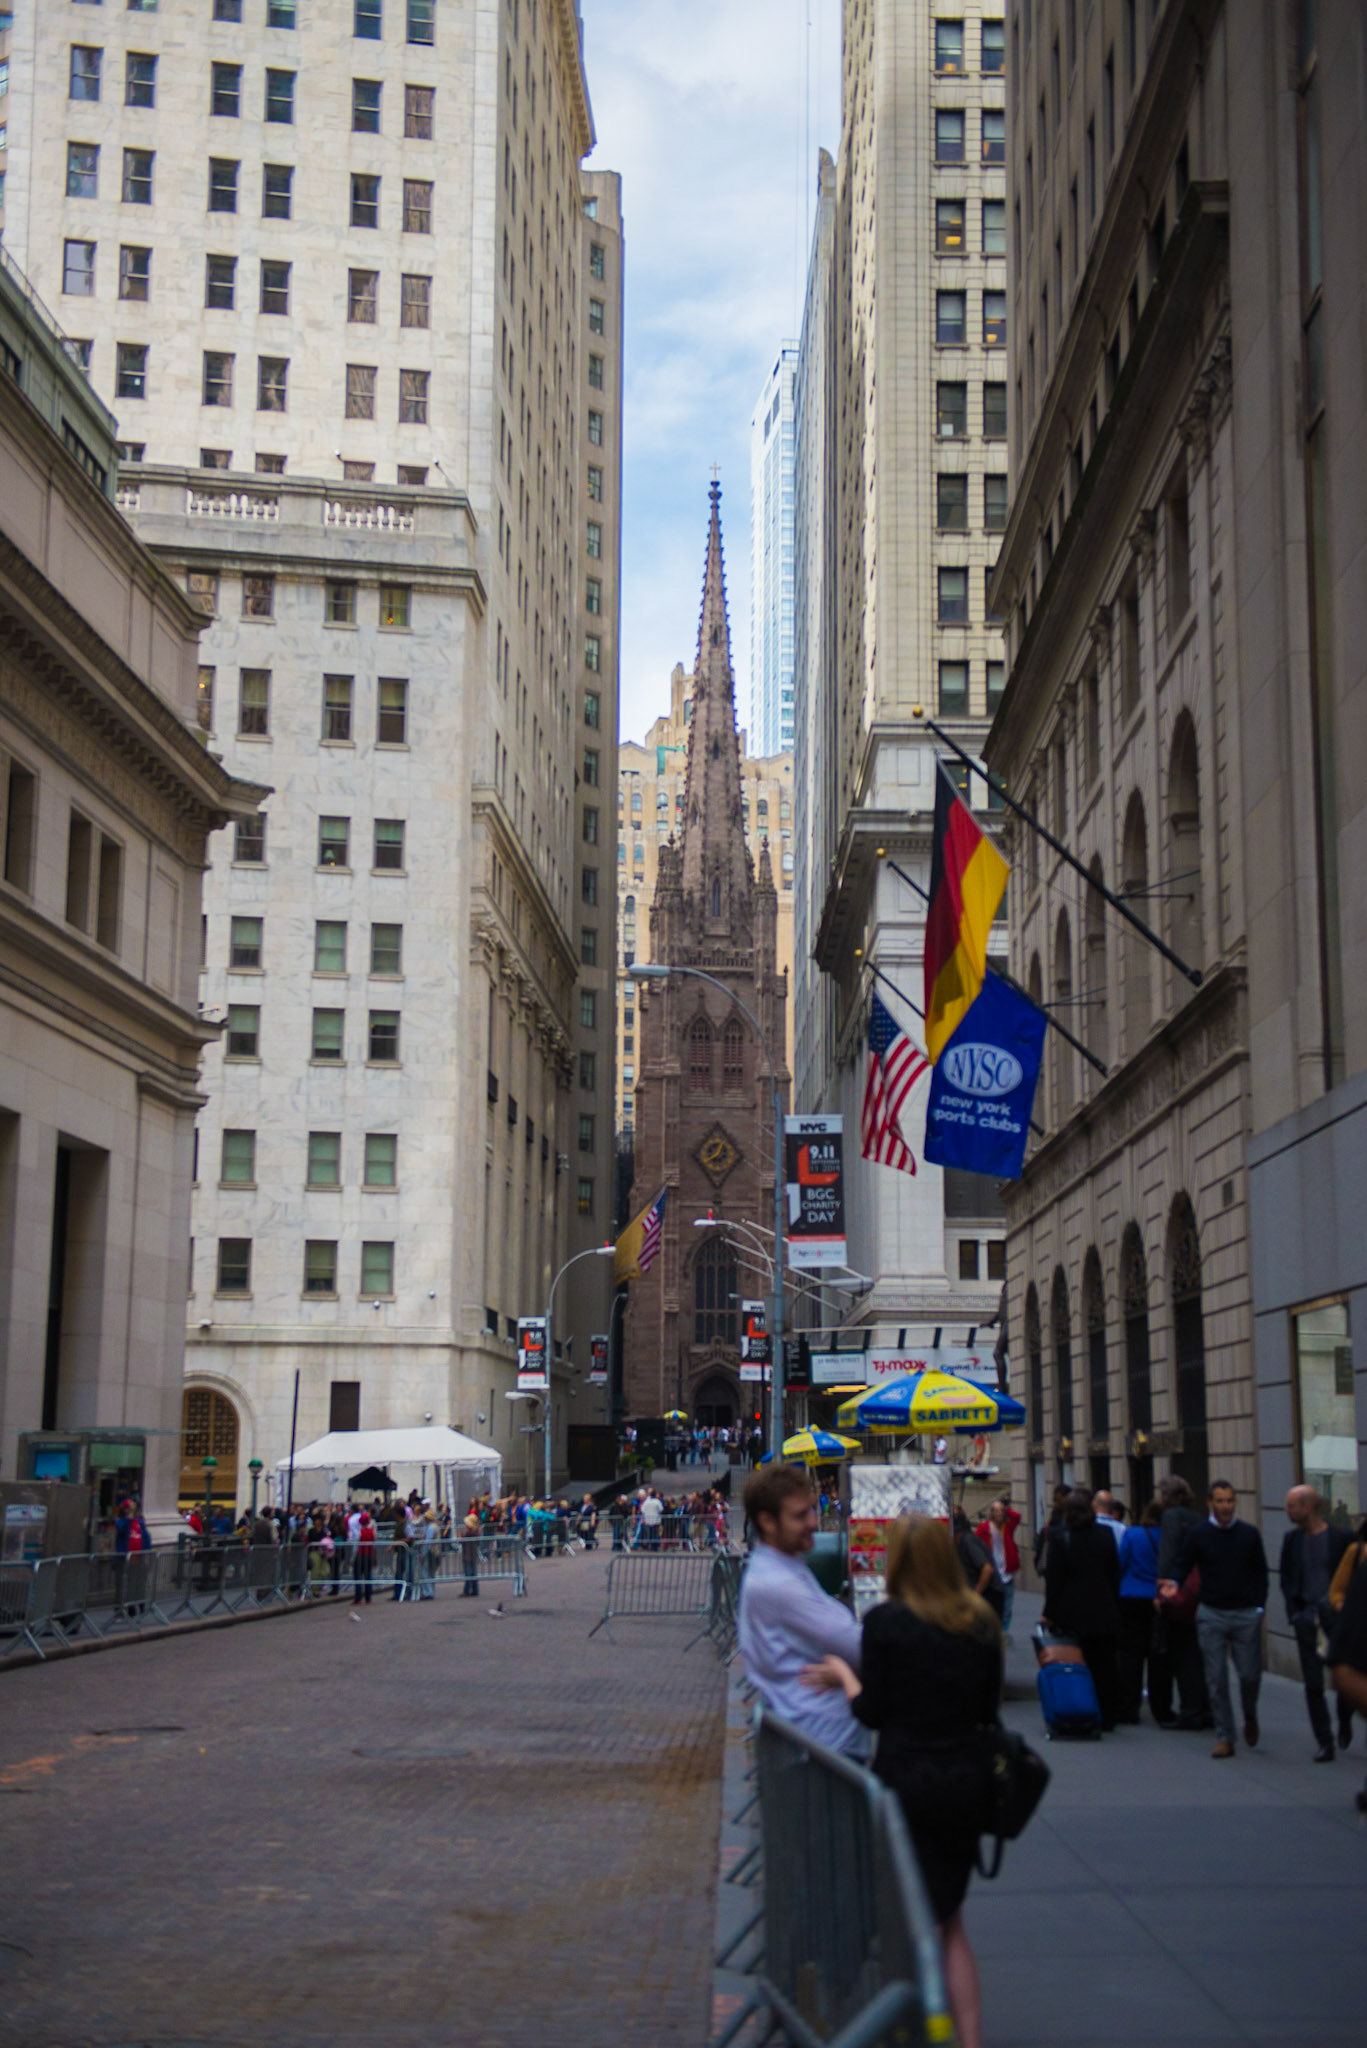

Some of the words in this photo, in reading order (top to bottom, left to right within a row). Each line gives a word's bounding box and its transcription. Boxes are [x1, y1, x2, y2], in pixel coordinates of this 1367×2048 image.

[950, 1047, 1013, 1091] NYSC
[941, 1095, 973, 1109] new
[976, 1101, 1010, 1115] york
[800, 1122, 827, 1132] NYC
[933, 1108, 976, 1126] ports
[979, 1115, 1021, 1133] clubs
[809, 1144, 835, 1159] 9.11
[807, 1187, 835, 1201] BGC
[802, 1200, 841, 1210] CHARITY
[807, 1210, 836, 1223] DAY
[916, 1406, 991, 1423] SABRETT
